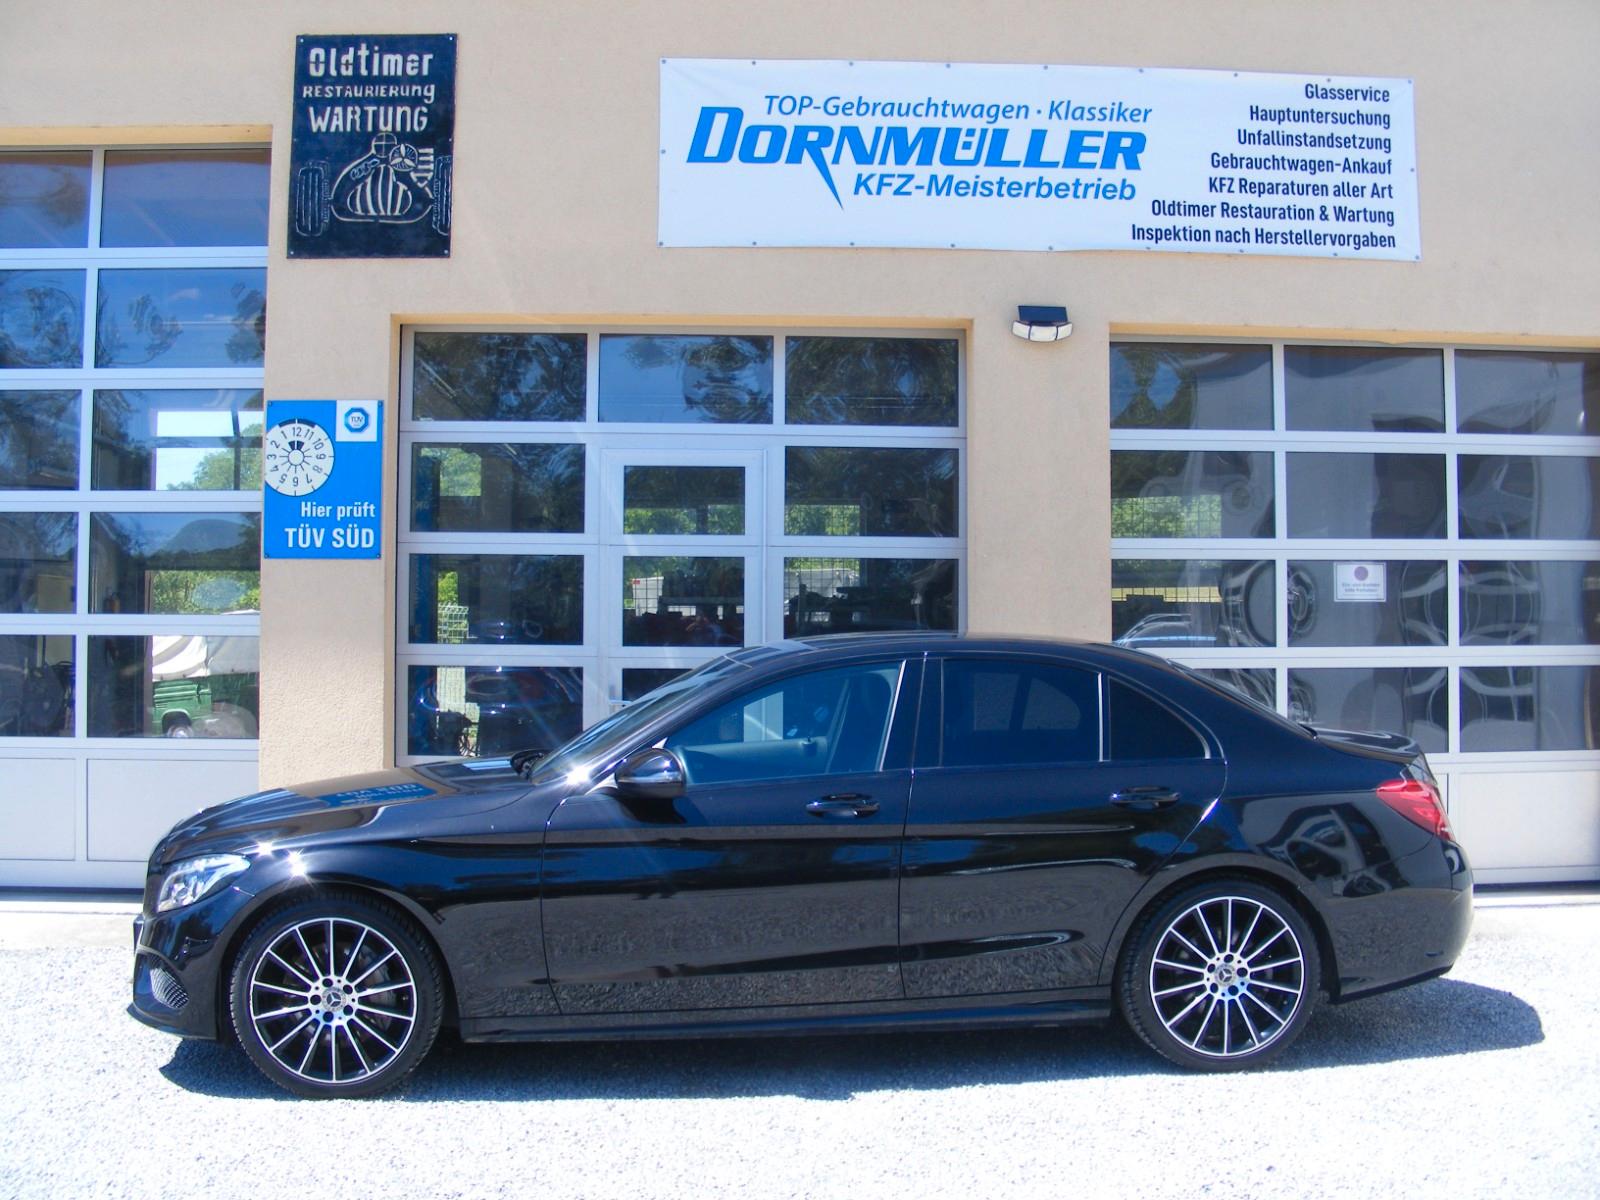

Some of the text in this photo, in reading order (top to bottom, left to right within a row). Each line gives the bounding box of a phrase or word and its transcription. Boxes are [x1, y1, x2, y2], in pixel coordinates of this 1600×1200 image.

[309, 43, 433, 77] Oldtimer
[1304, 83, 1391, 102] Glasservice
[764, 95, 1153, 123] TOP-Gebrauchtwagen Klassiker
[1249, 105, 1391, 129] Hauptuntersuchung
[1237, 129, 1392, 153] Unfallinstandsetzung
[1210, 152, 1392, 175] Gebrauchtwagen-Ankauf
[853, 173, 1136, 200] KFZ-Meisterbetrieb
[1209, 177, 1393, 199] KFZ Reparaturen aller Art
[1151, 200, 1395, 227] Oldtimer Restauration & Wartung
[1131, 224, 1396, 250] Inspektion nach Herstellervorgaben
[292, 426, 302, 437] 12
[301, 501, 376, 521] Hier prüft
[284, 524, 375, 549] TÜV SÜD
